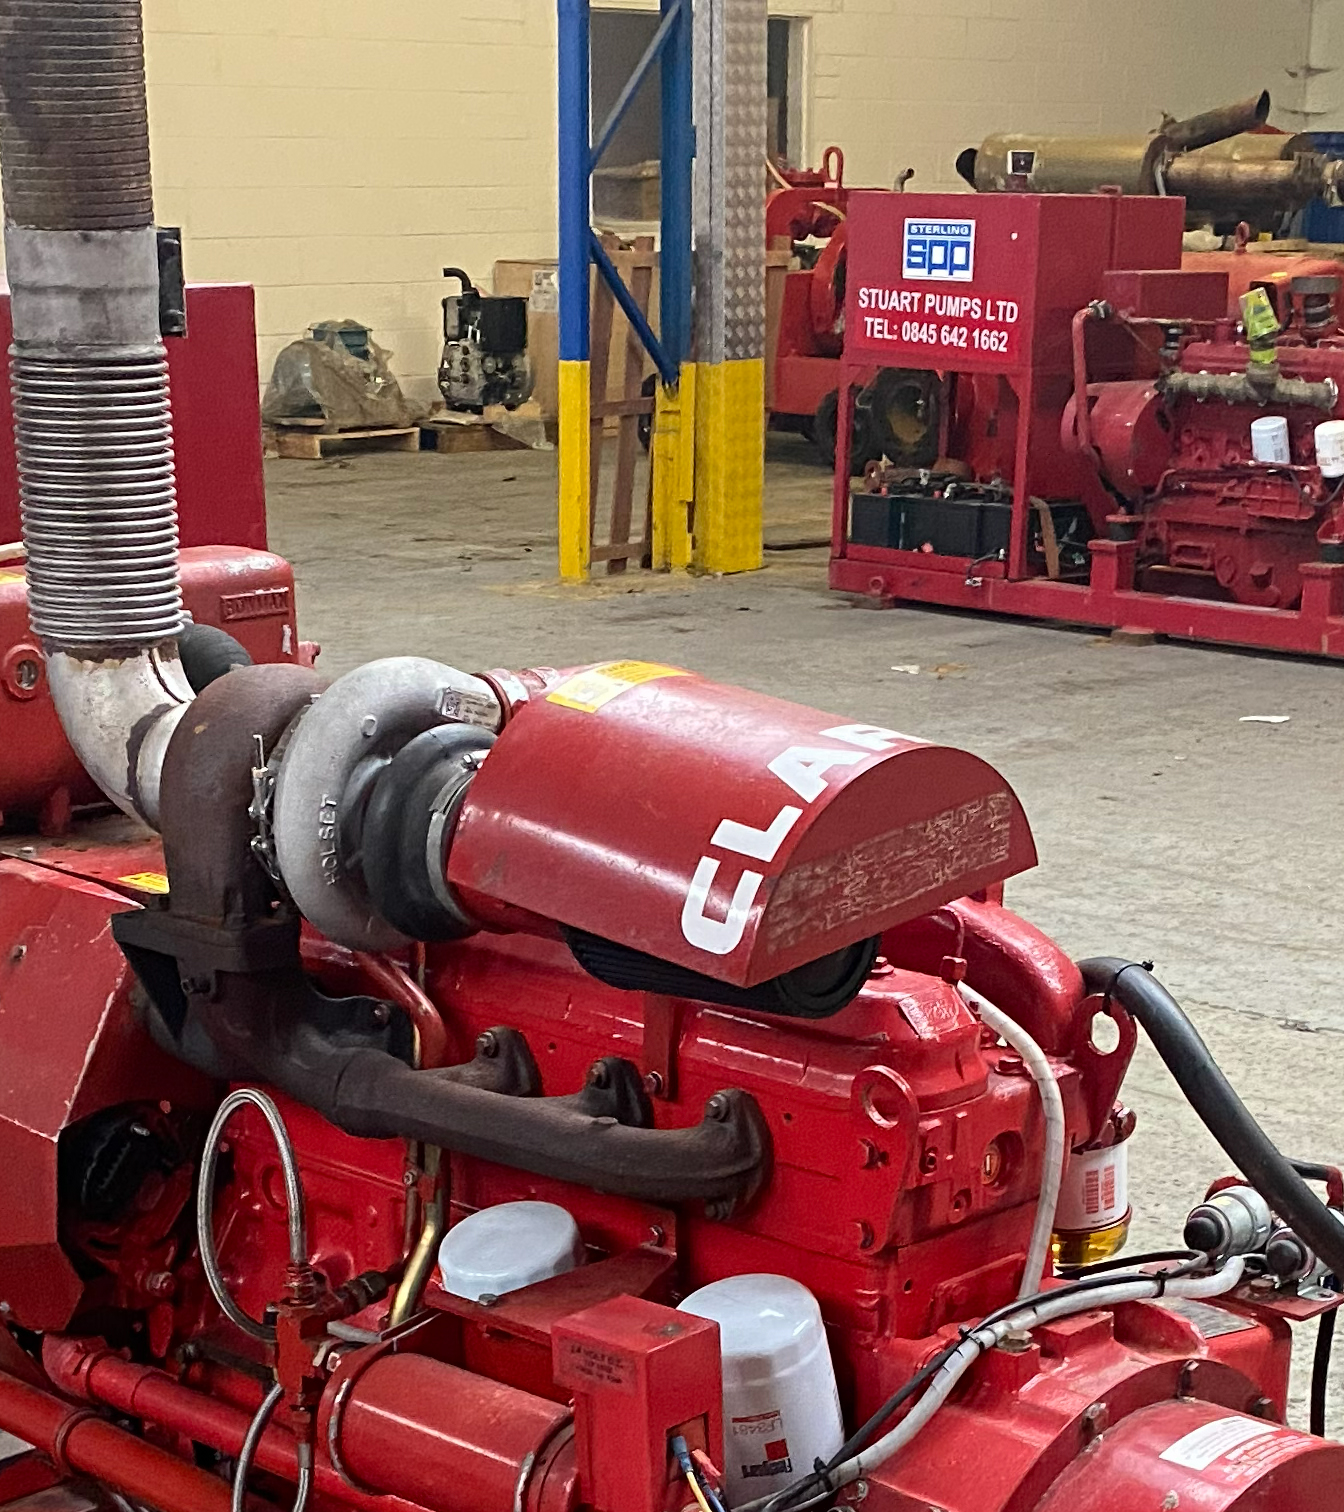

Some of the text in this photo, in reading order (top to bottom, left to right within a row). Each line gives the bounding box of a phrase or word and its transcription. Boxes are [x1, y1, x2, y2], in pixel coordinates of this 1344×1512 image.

[910, 225, 969, 235] STERLING
[858, 287, 1019, 323] STUART PUMPS LTD
[864, 316, 1009, 353] TEL: 0845 642 1662
[318, 792, 339, 886] HOLSET
